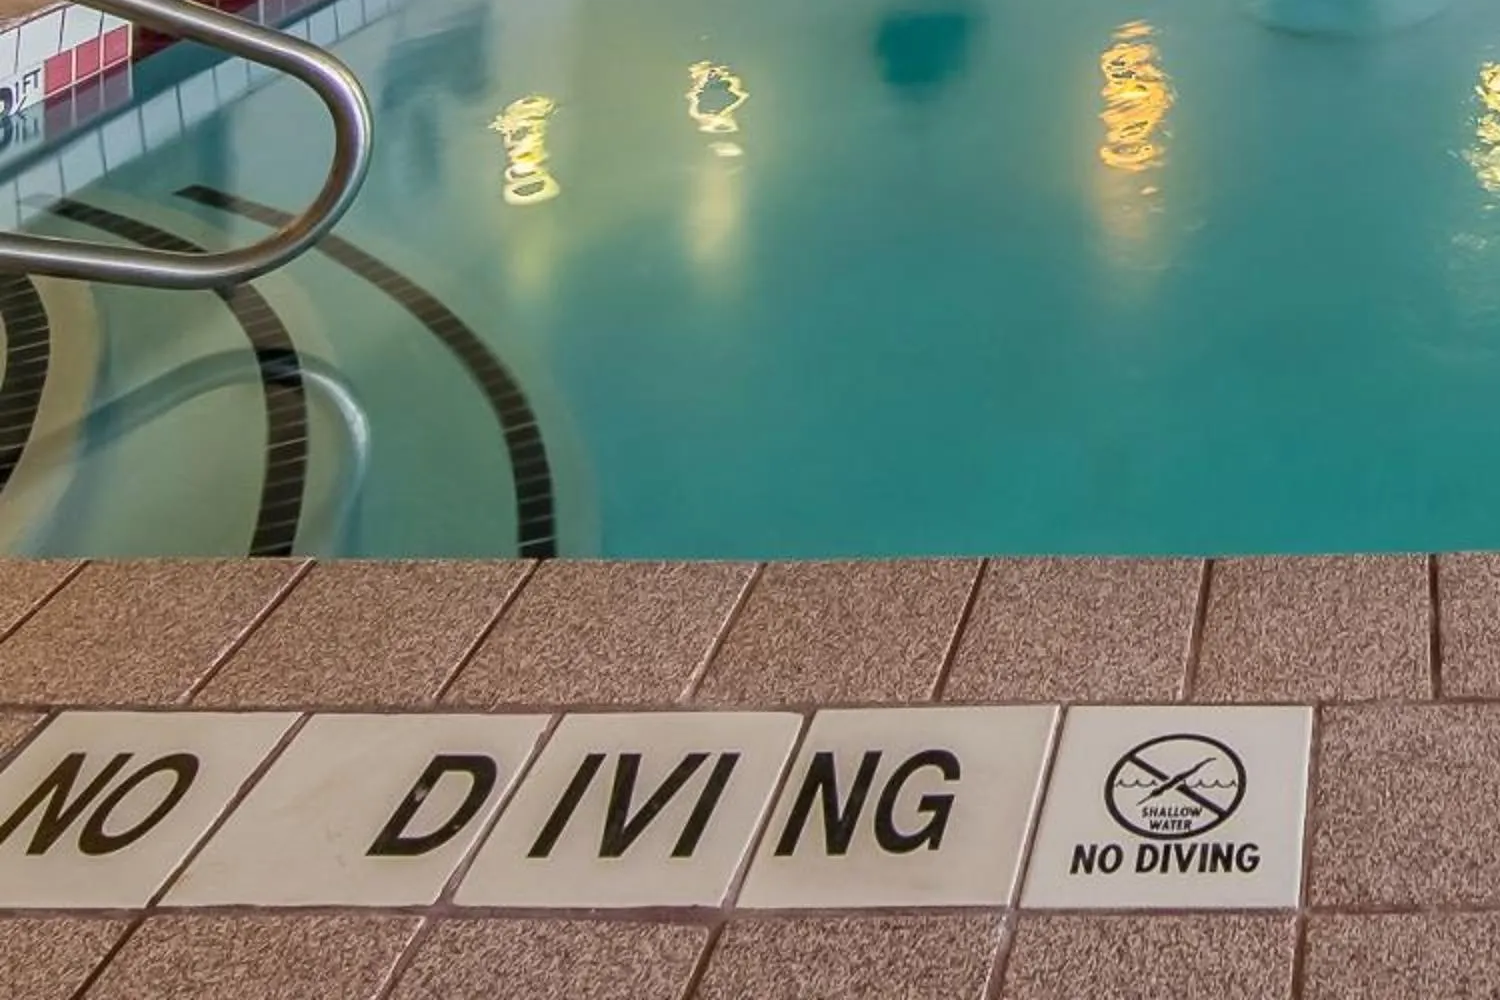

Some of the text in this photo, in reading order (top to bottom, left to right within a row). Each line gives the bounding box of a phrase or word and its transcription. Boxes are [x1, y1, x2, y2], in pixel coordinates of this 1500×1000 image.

[0, 752, 200, 856] NO
[1141, 806, 1203, 818] SHALLOW
[1149, 819, 1193, 831] WATER
[1069, 842, 1262, 875] NO DIVING
